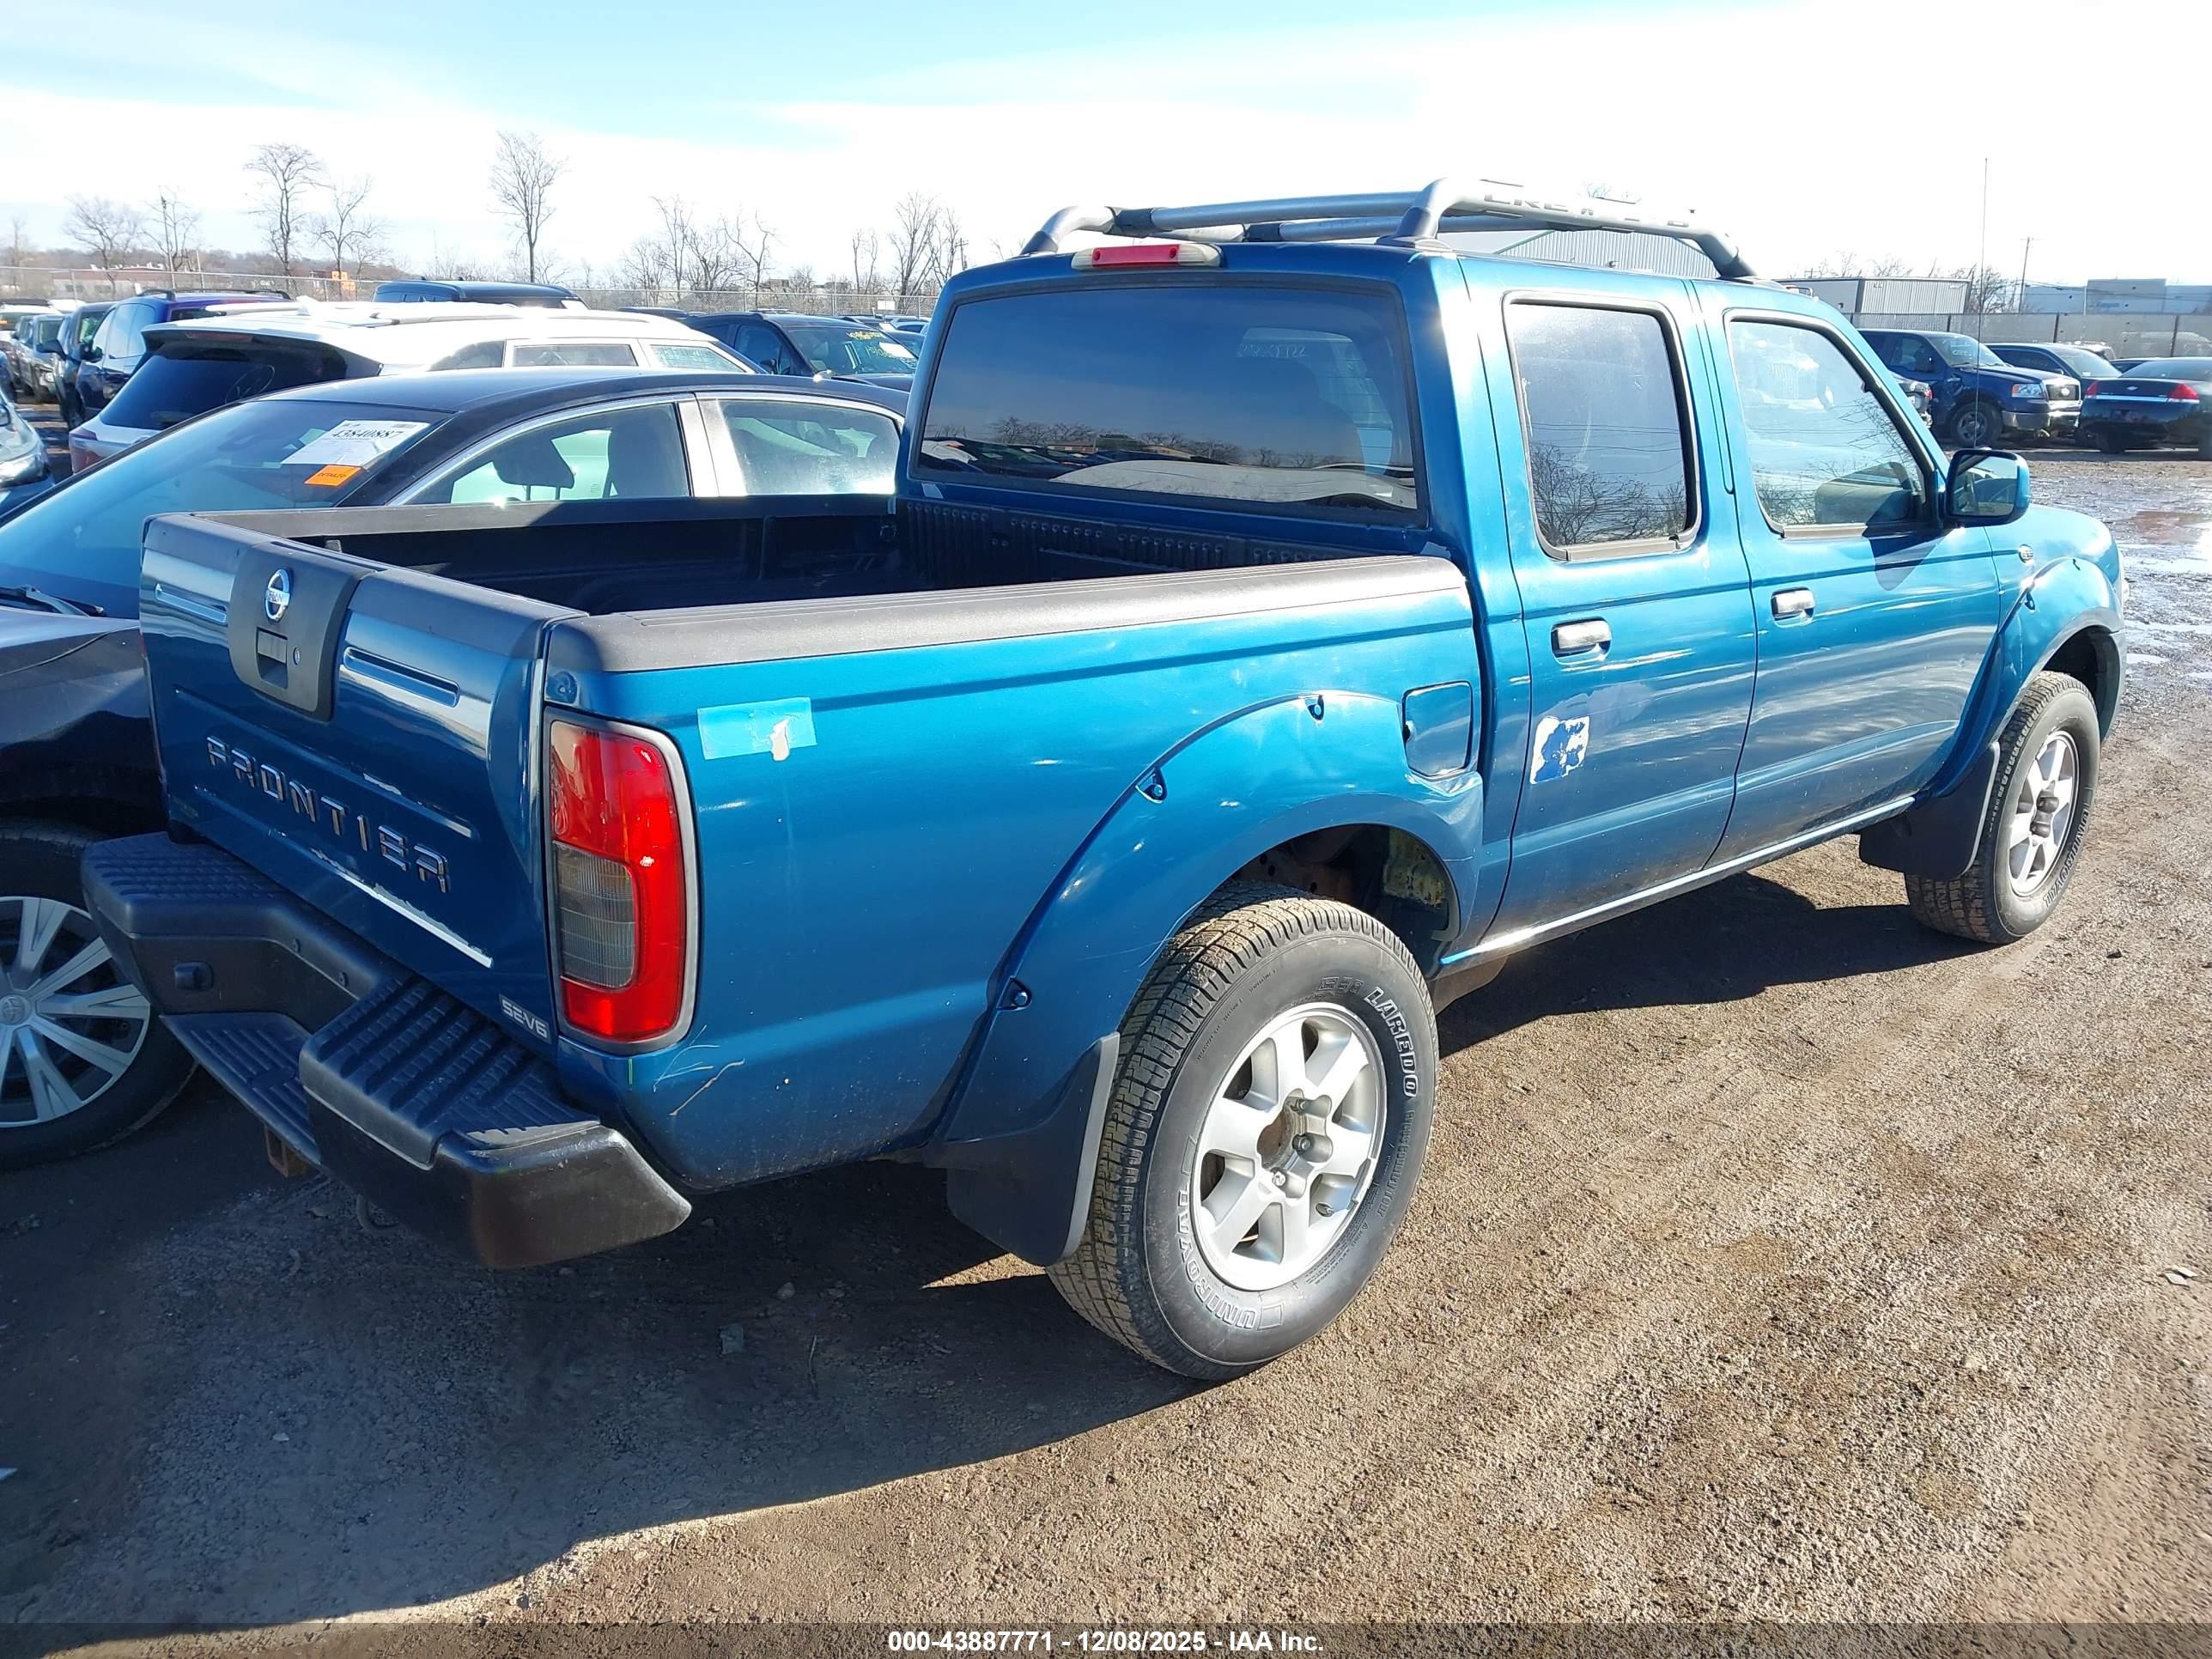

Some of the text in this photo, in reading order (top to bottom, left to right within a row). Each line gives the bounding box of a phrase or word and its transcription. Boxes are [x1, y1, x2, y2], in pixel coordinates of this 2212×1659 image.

[331, 428, 404, 439] 43840887
[206, 735, 449, 894] FRONTIER
[1363, 986, 1418, 1097] LAREDO
[1178, 1182, 1257, 1329] UNIROYAL
